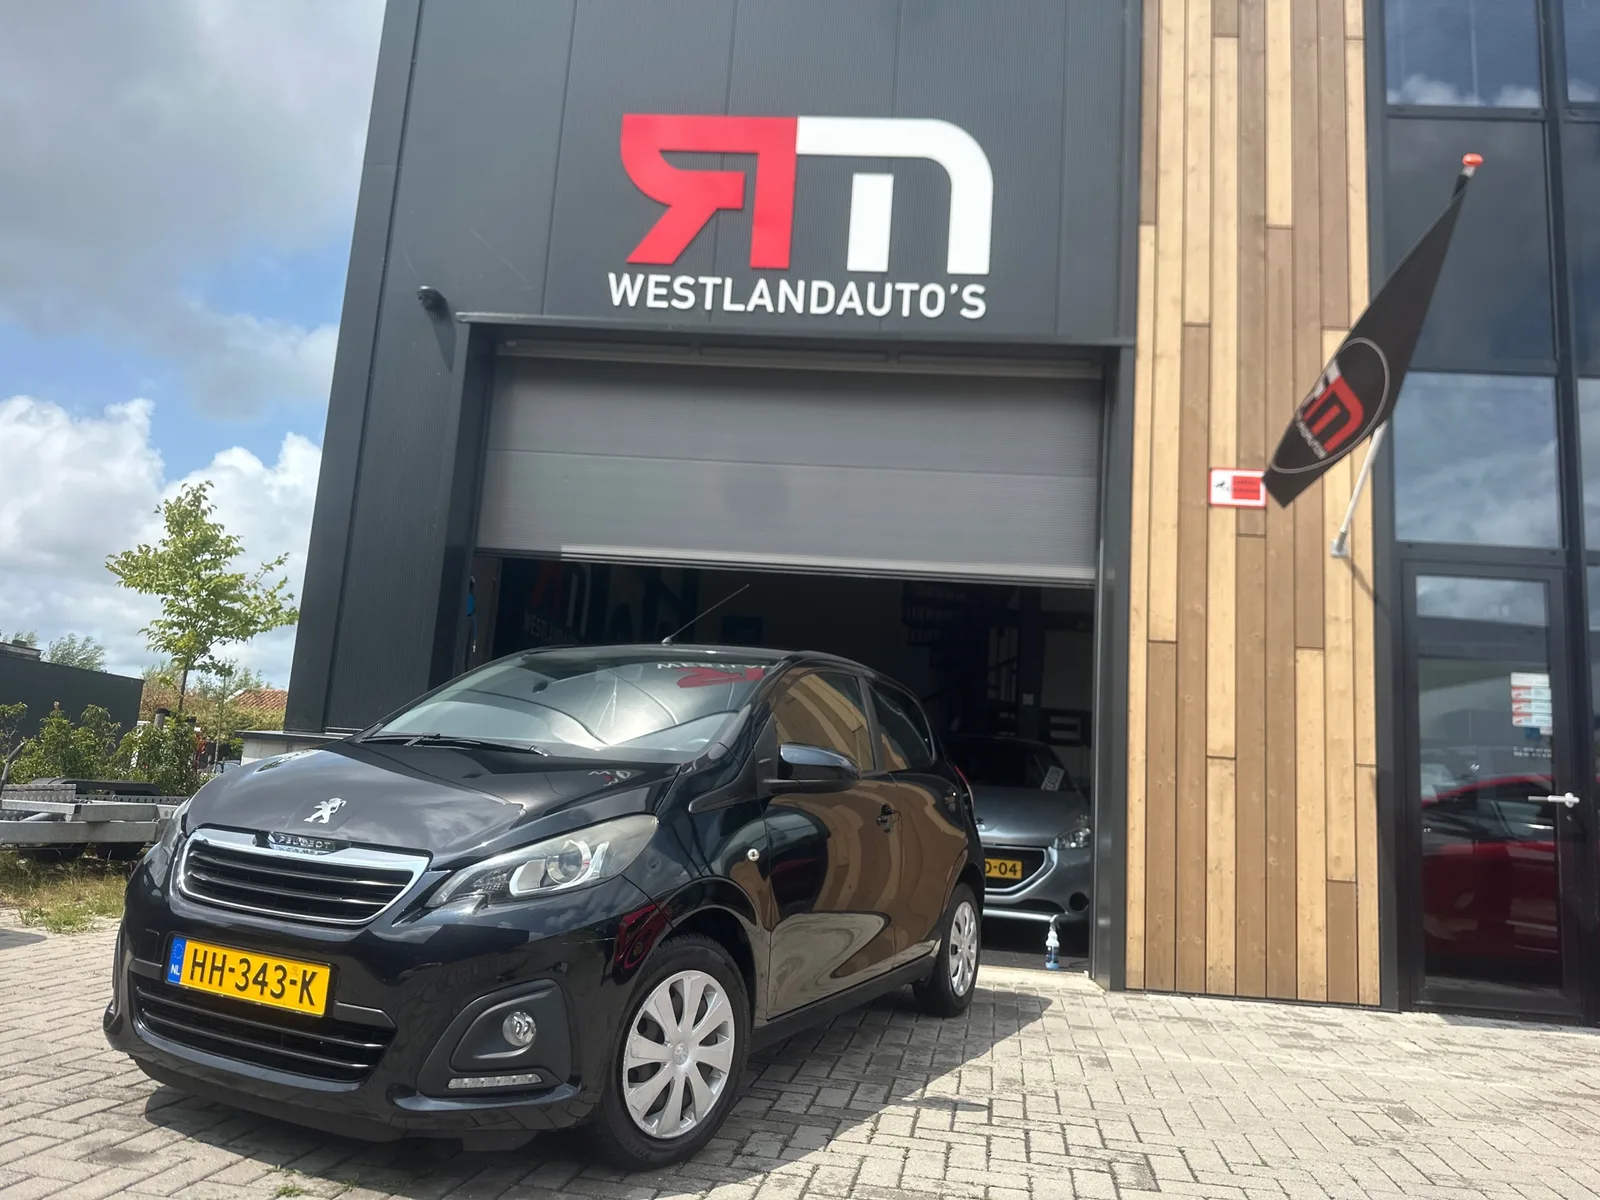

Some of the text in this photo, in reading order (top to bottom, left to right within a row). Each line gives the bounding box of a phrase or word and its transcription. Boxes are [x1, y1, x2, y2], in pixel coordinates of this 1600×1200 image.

[608, 272, 987, 320] WESTLANDAUTO'S
[170, 964, 181, 976] NL
[189, 948, 317, 1006] HH-343-K
